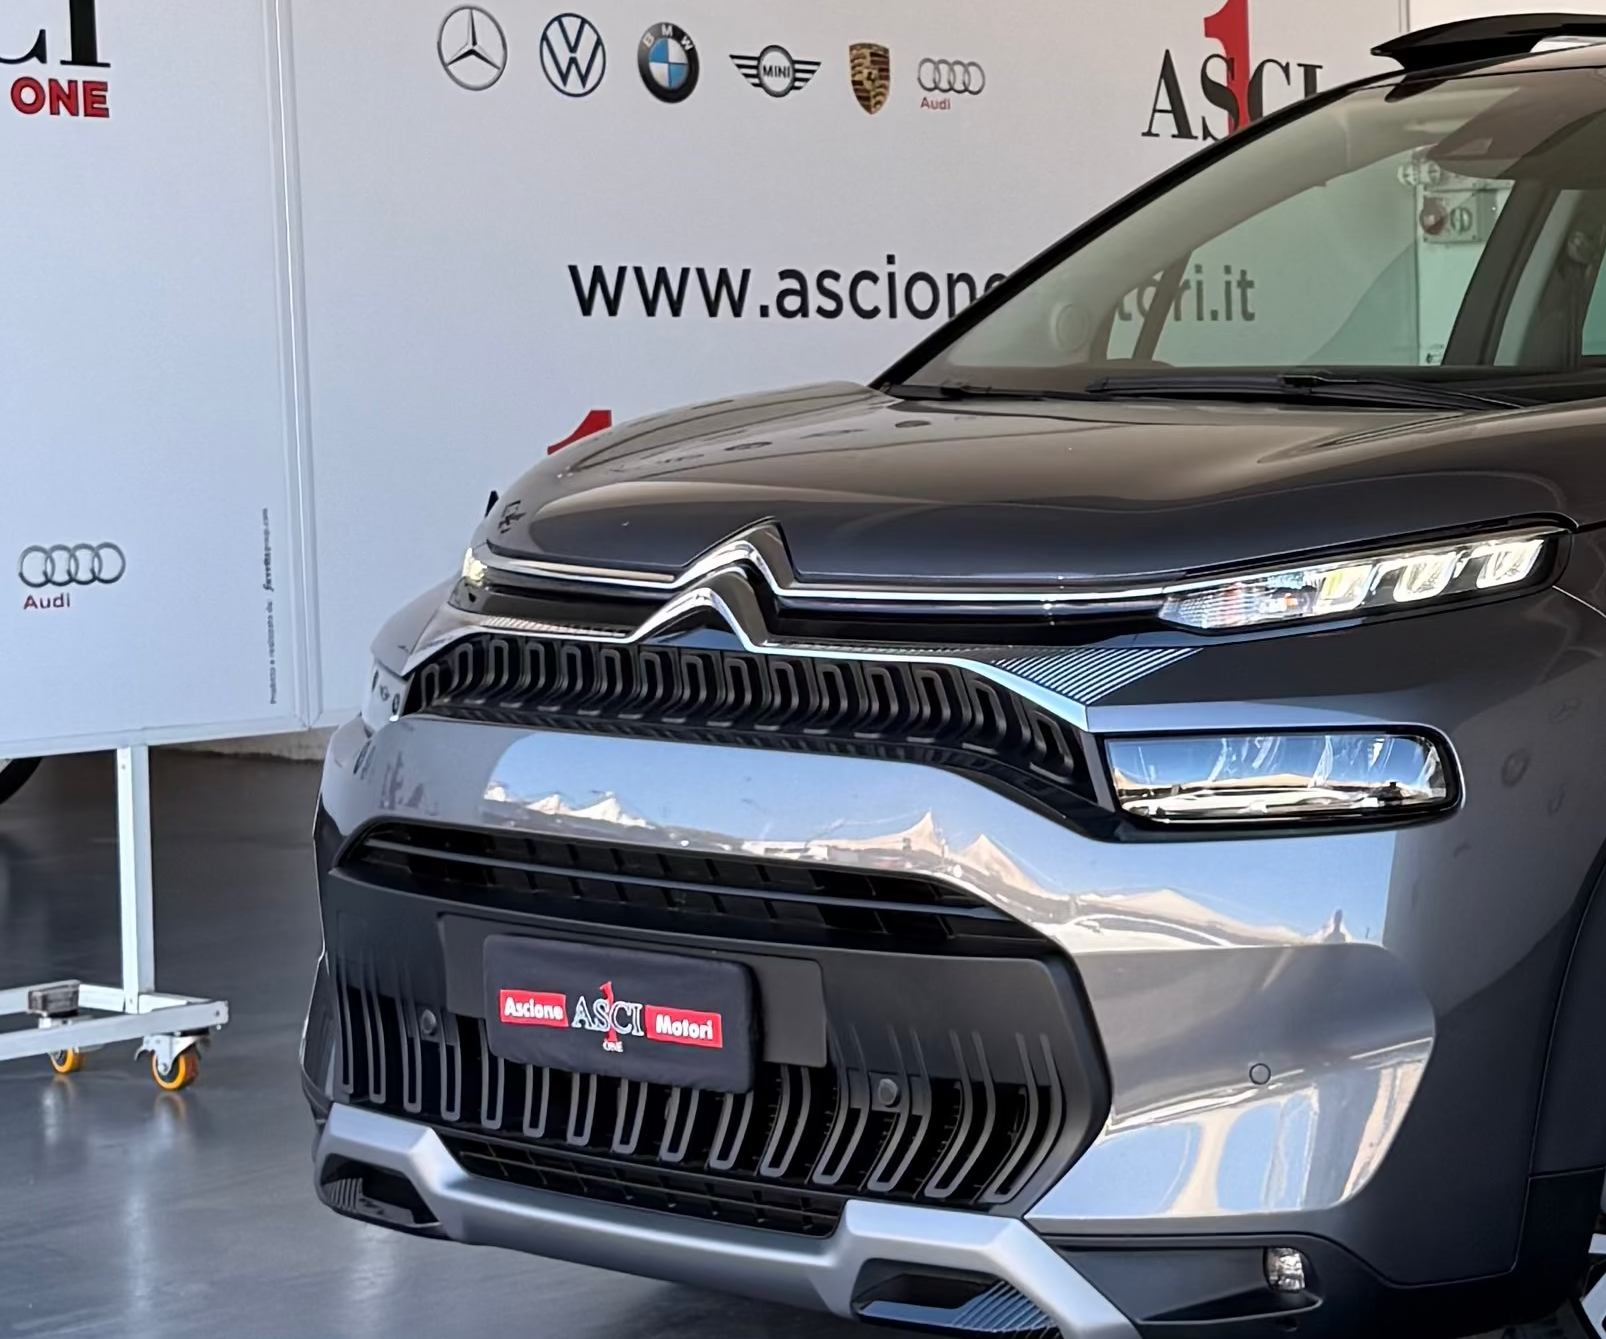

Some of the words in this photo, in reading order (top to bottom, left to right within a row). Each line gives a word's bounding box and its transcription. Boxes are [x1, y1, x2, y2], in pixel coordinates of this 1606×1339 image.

[763, 64, 791, 78] MINI
[10, 75, 111, 118] ONE
[920, 96, 951, 110] Audi
[23, 593, 71, 610] Audi
[504, 996, 564, 1020] Ascione
[571, 995, 645, 1037] ASCI
[655, 1014, 714, 1040] Motori
